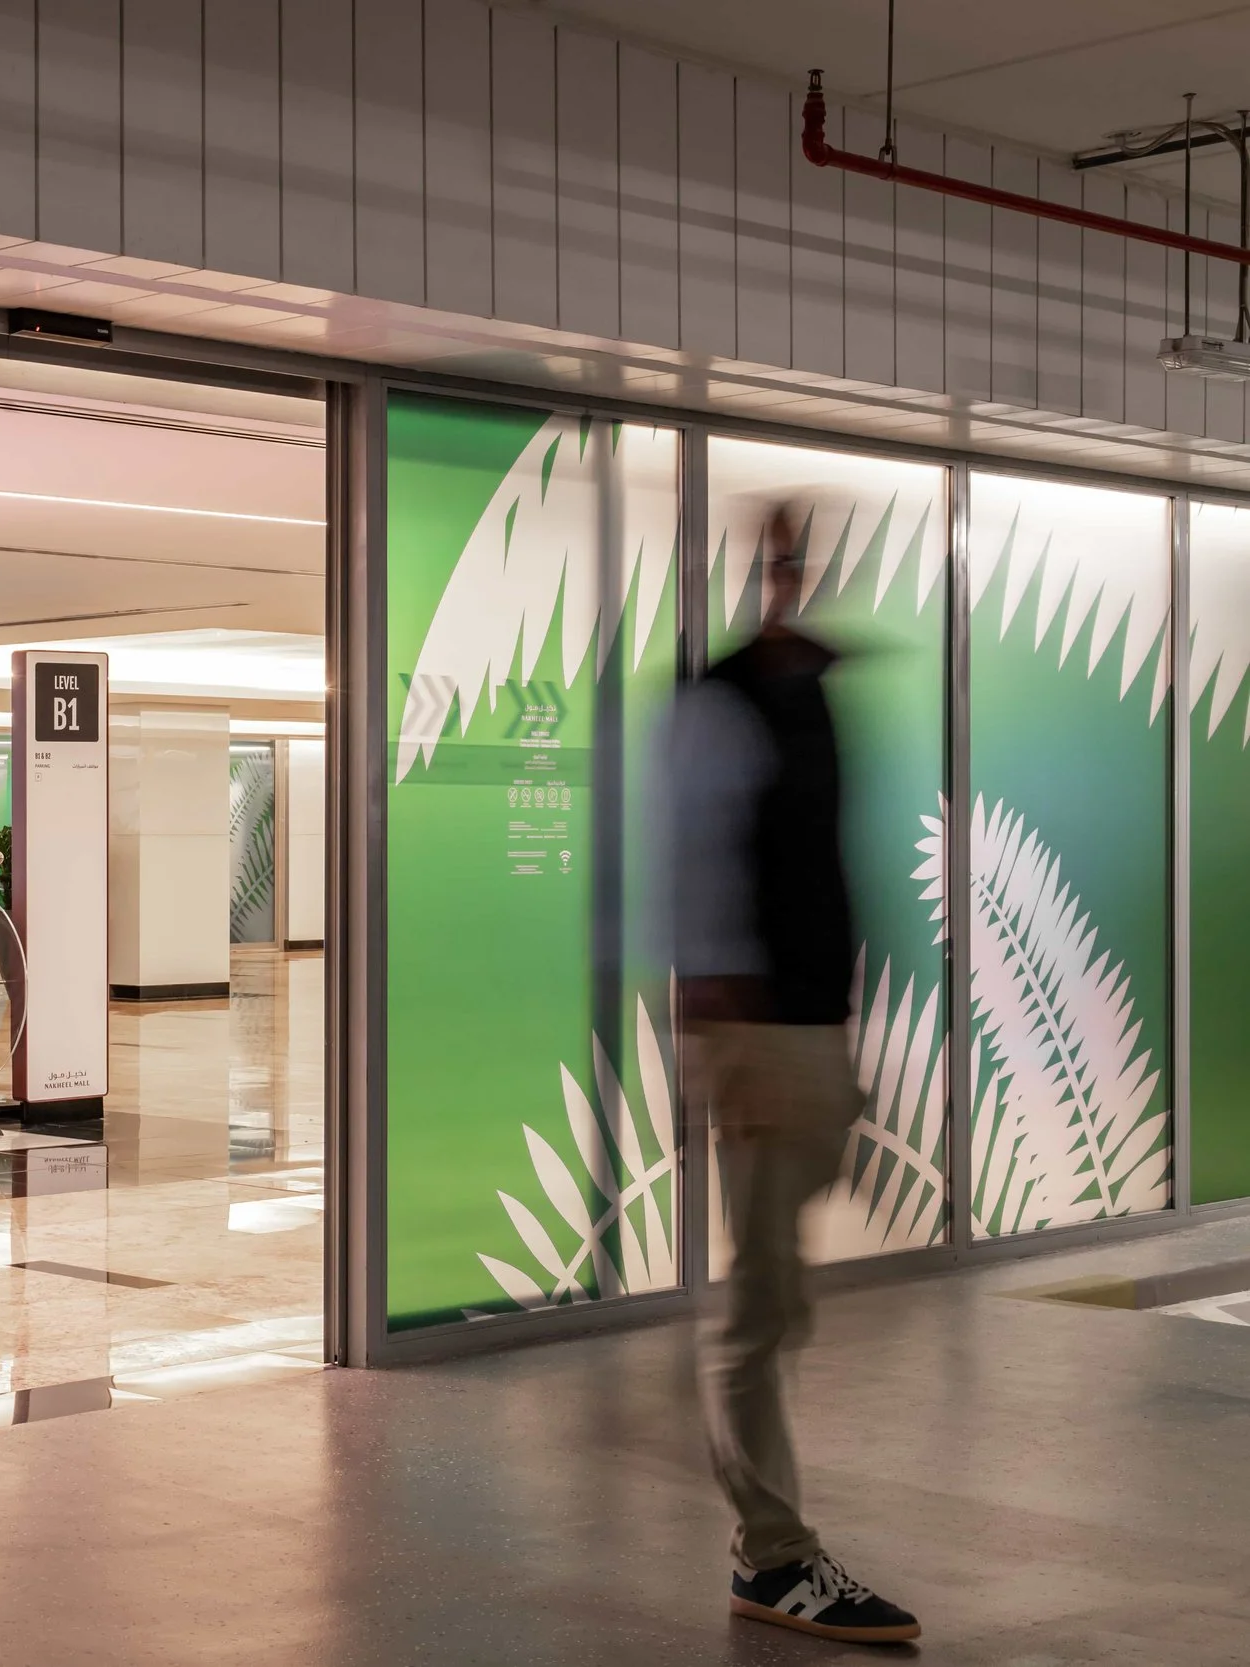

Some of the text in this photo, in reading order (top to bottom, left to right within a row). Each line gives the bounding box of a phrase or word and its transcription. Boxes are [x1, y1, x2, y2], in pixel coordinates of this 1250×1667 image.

[54, 675, 80, 690] LEVEL
[53, 697, 80, 731] B1
[44, 1081, 73, 1090] NAKHEEL
